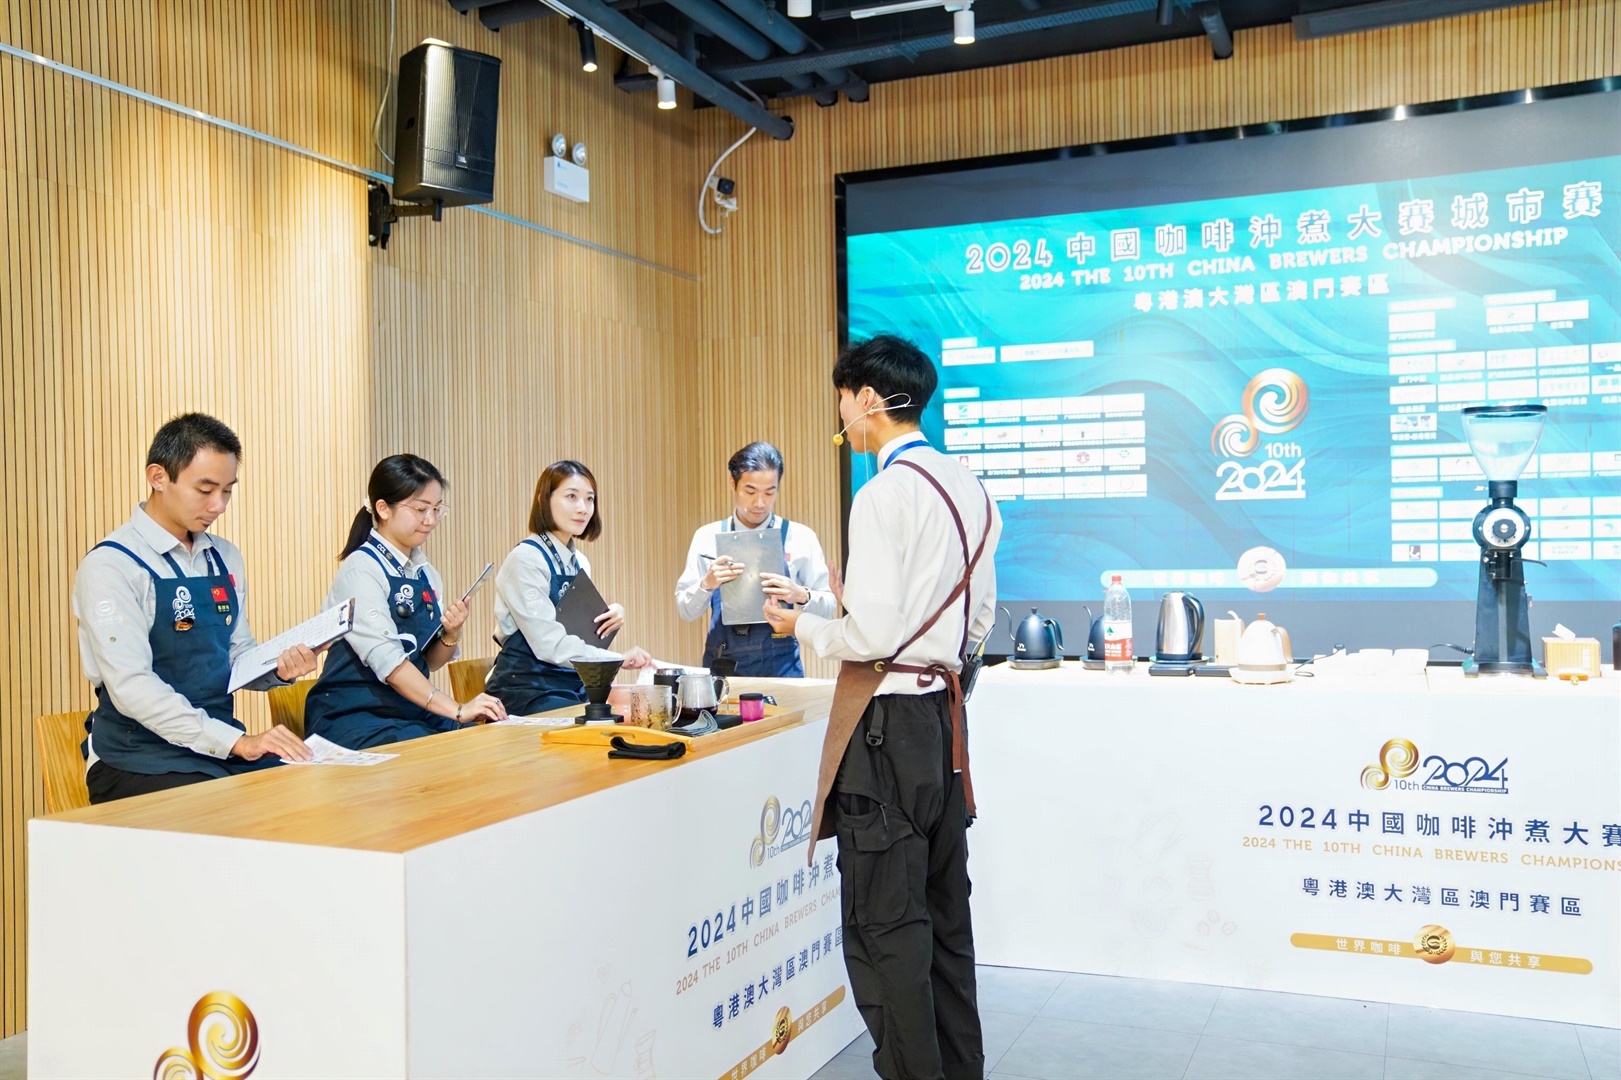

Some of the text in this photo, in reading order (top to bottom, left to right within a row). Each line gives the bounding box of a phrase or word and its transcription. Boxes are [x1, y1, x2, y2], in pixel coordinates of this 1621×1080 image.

[965, 180, 1603, 274] 2024中國咖啡沖煮大賽城市賽
[1019, 226, 1569, 290] 2024 THE 10TH CHINA BREWERS CHAMPIONSHIP
[1264, 442, 1302, 458] 10th
[1215, 458, 1306, 499] 2024
[1394, 779, 1419, 791] 10th
[1422, 755, 1508, 788] 2024
[781, 799, 812, 847] 202
[1258, 804, 1621, 848] 2024中國咖啡沖煮大賽
[1242, 836, 1276, 848] 2024
[1283, 839, 1312, 851] THE
[1323, 841, 1361, 854] 10TH
[1372, 844, 1423, 858] CHINA
[1434, 848, 1509, 864] BREWERS
[1302, 877, 1582, 917] 粵港澳大灣區澳門賽區
[676, 969, 699, 995] 2024
[702, 956, 721, 978] THE
[726, 940, 748, 965] 10TH
[753, 922, 780, 948] CHINA
[784, 899, 817, 929] BREWERS
[1335, 938, 1401, 955] 世界咖啡
[1470, 949, 1542, 969] 與您共享
